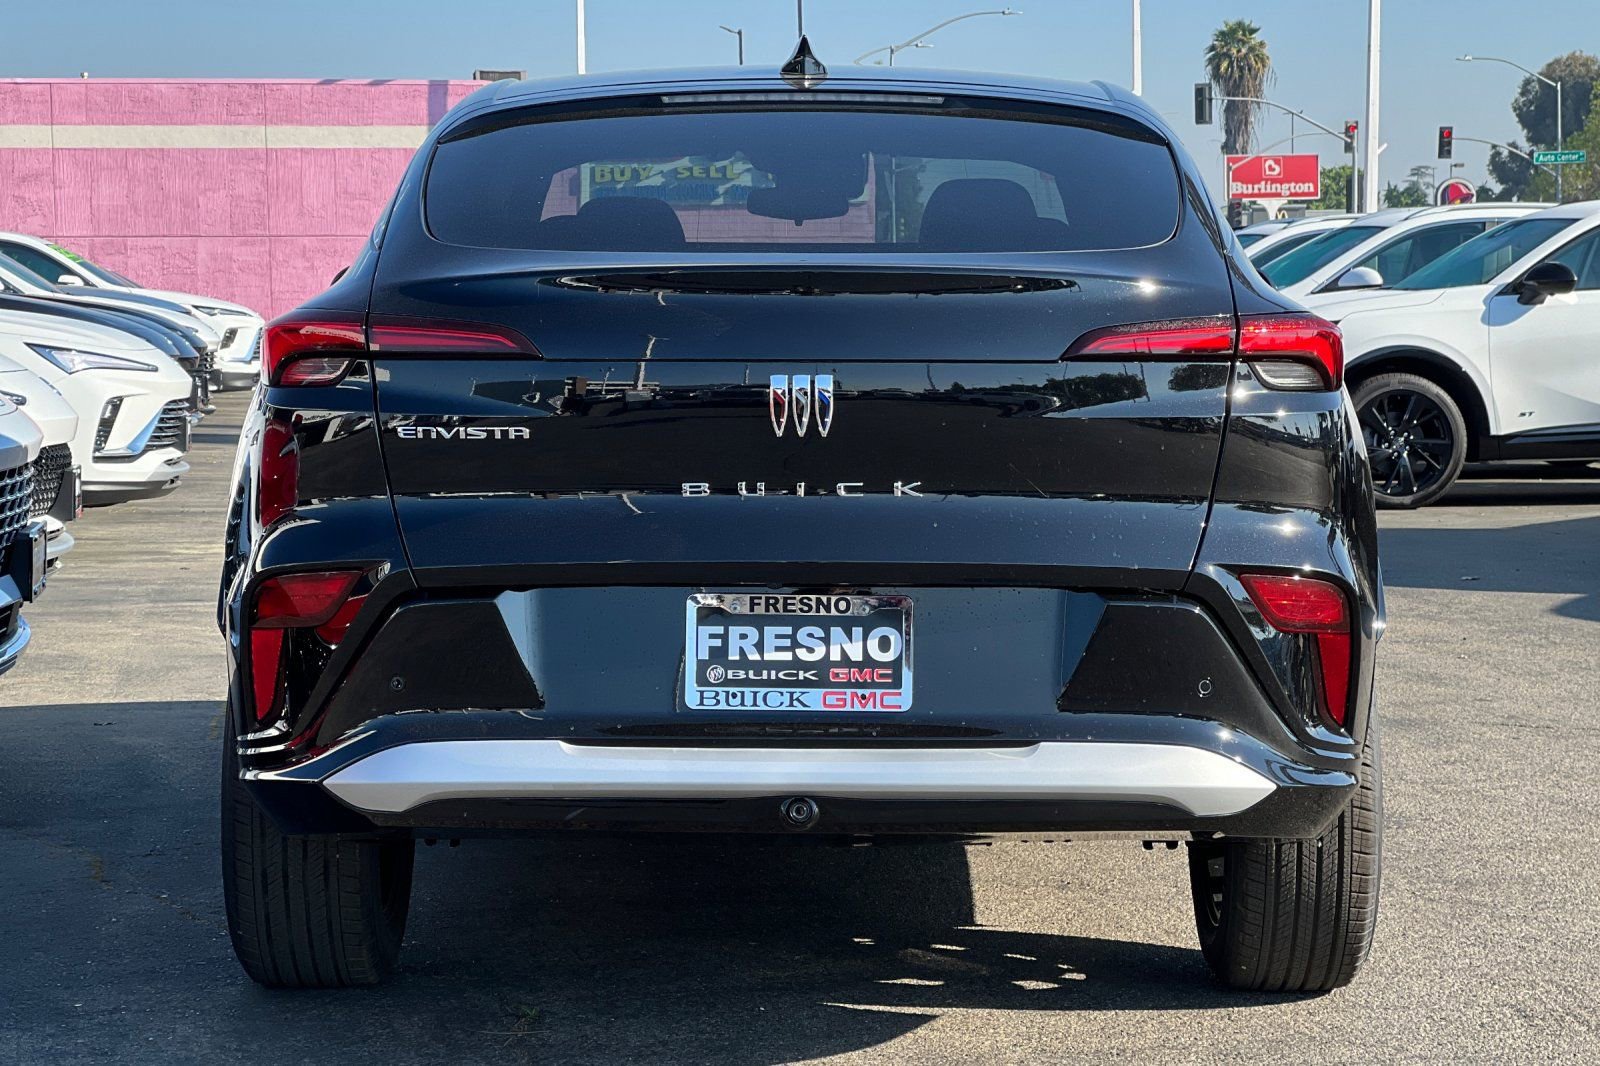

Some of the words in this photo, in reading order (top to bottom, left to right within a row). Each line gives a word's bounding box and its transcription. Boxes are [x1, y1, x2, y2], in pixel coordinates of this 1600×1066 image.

[1539, 154, 1556, 162] Auto
[1557, 153, 1579, 161] Center
[594, 164, 653, 183] BUY
[676, 162, 742, 180] SELL
[1231, 180, 1315, 197] Burlington
[397, 426, 531, 440] ENVISTA
[681, 481, 923, 497] BUICK
[749, 596, 852, 614] FRESNO
[697, 626, 903, 662] FRESNO
[727, 669, 819, 680] BUICK
[829, 668, 893, 682] GMC
[696, 690, 811, 708] BUICK
[822, 691, 902, 709] GMC
